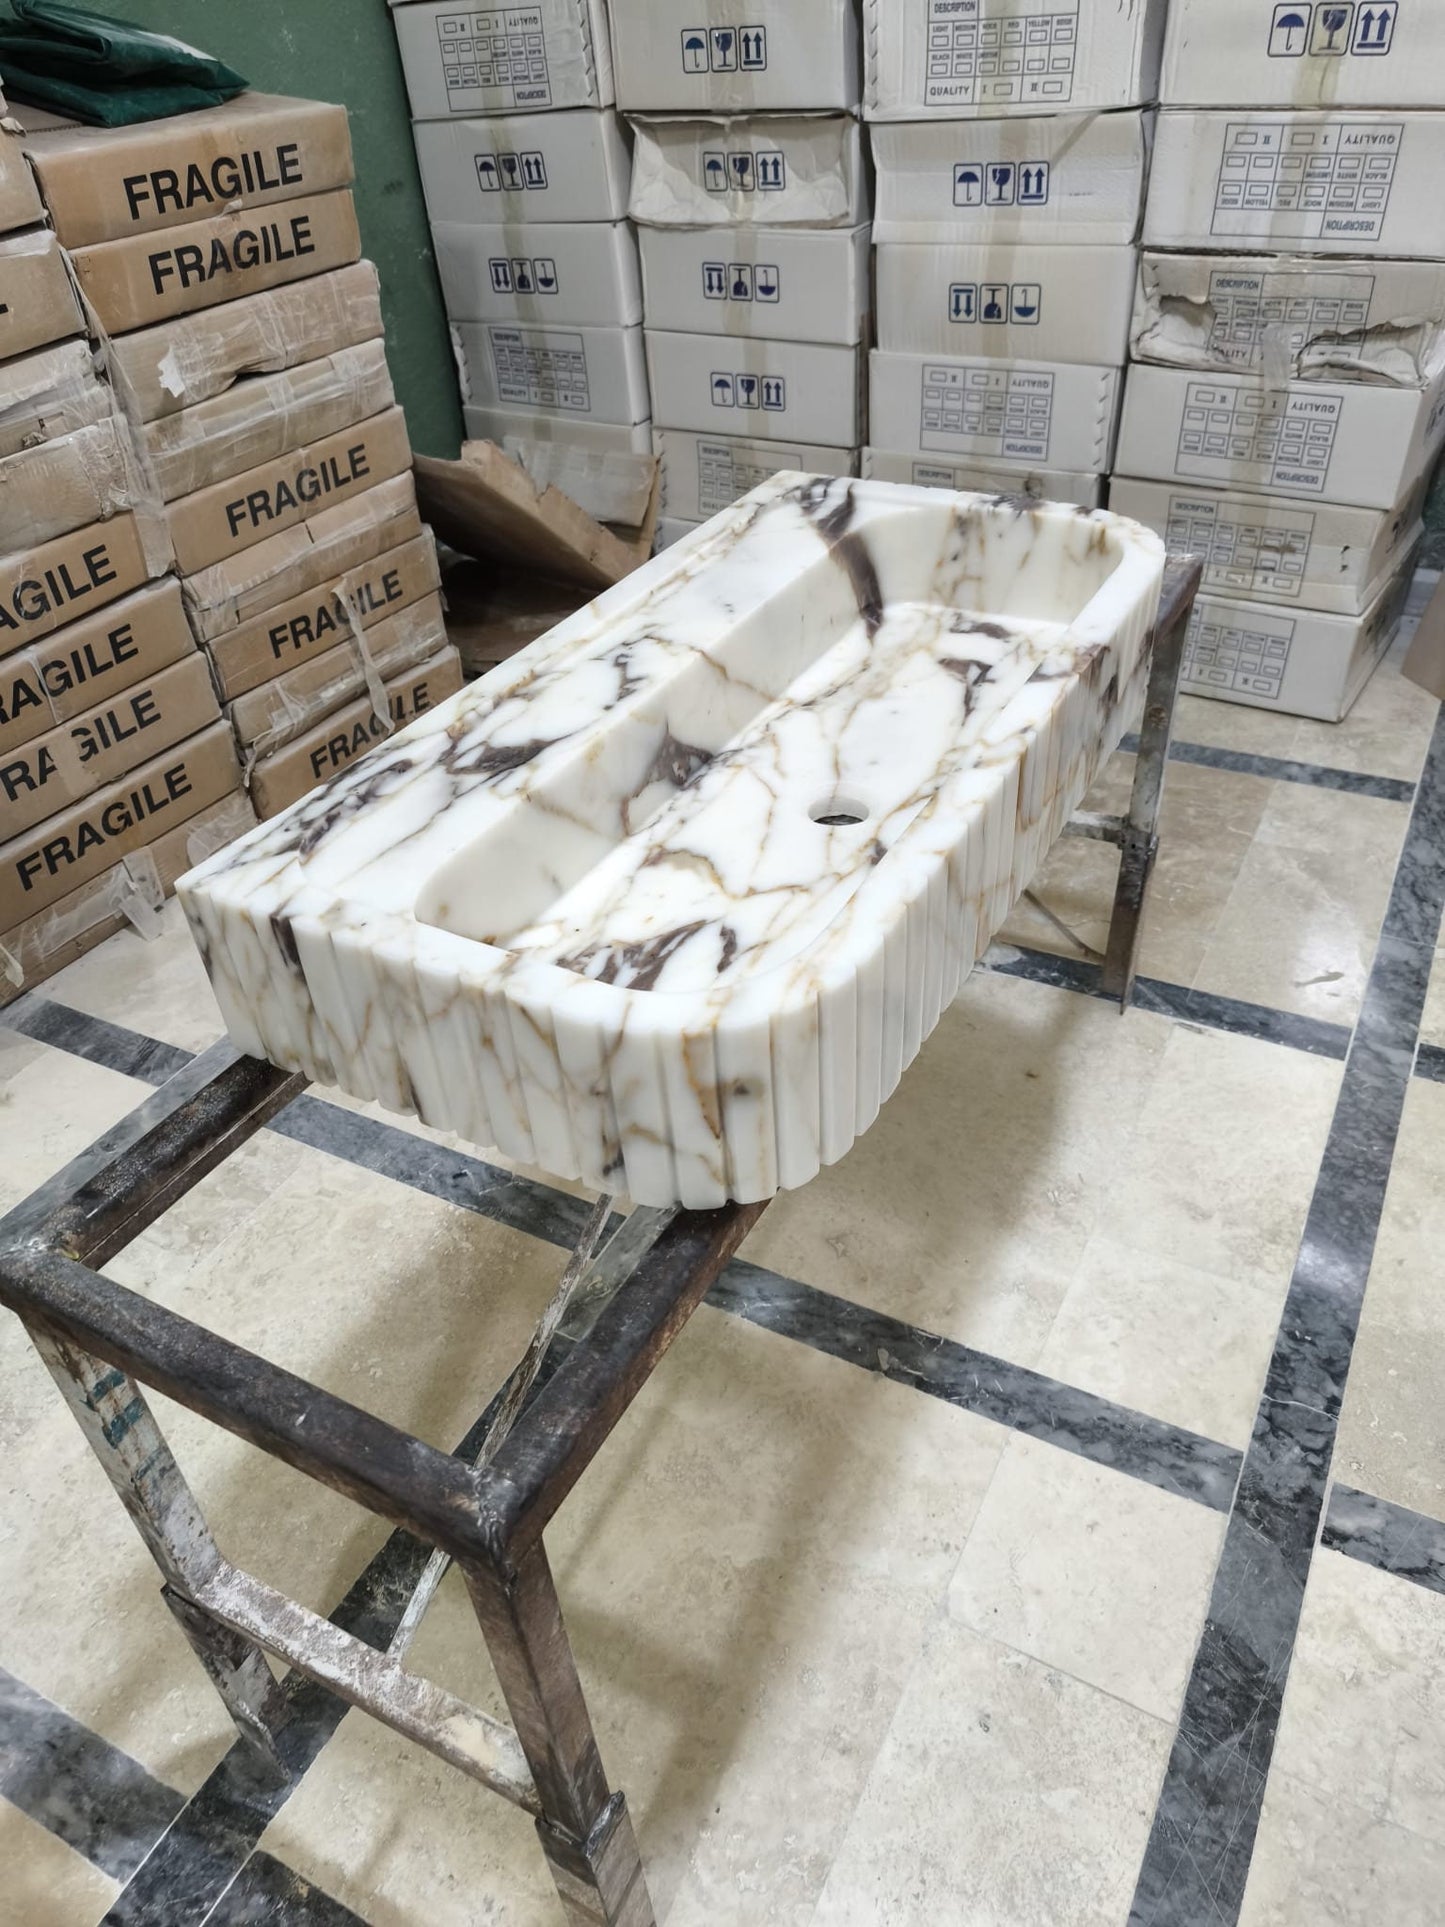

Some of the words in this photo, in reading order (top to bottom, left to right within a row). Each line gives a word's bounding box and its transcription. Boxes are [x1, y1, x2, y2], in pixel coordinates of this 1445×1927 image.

[934, 1, 975, 13] DESCRIPTION
[509, 16, 538, 27] QUALITY
[930, 86, 970, 96] QUALITY
[1263, 135, 1271, 145] II
[1322, 135, 1328, 145] I
[1344, 135, 1395, 145] QUALITY
[123, 144, 303, 220] FRAGILE
[1326, 220, 1375, 231] DESCRIPTION
[148, 216, 315, 295] FRAGILE
[1216, 278, 1258, 289] DESCRIPTION
[1012, 379, 1049, 389] QUALITY
[1291, 401, 1335, 414] QUALITY
[1276, 471, 1318, 484] DESCRIPTION
[226, 444, 370, 537] FRAGILE
[16, 763, 193, 891] FRAGILE
